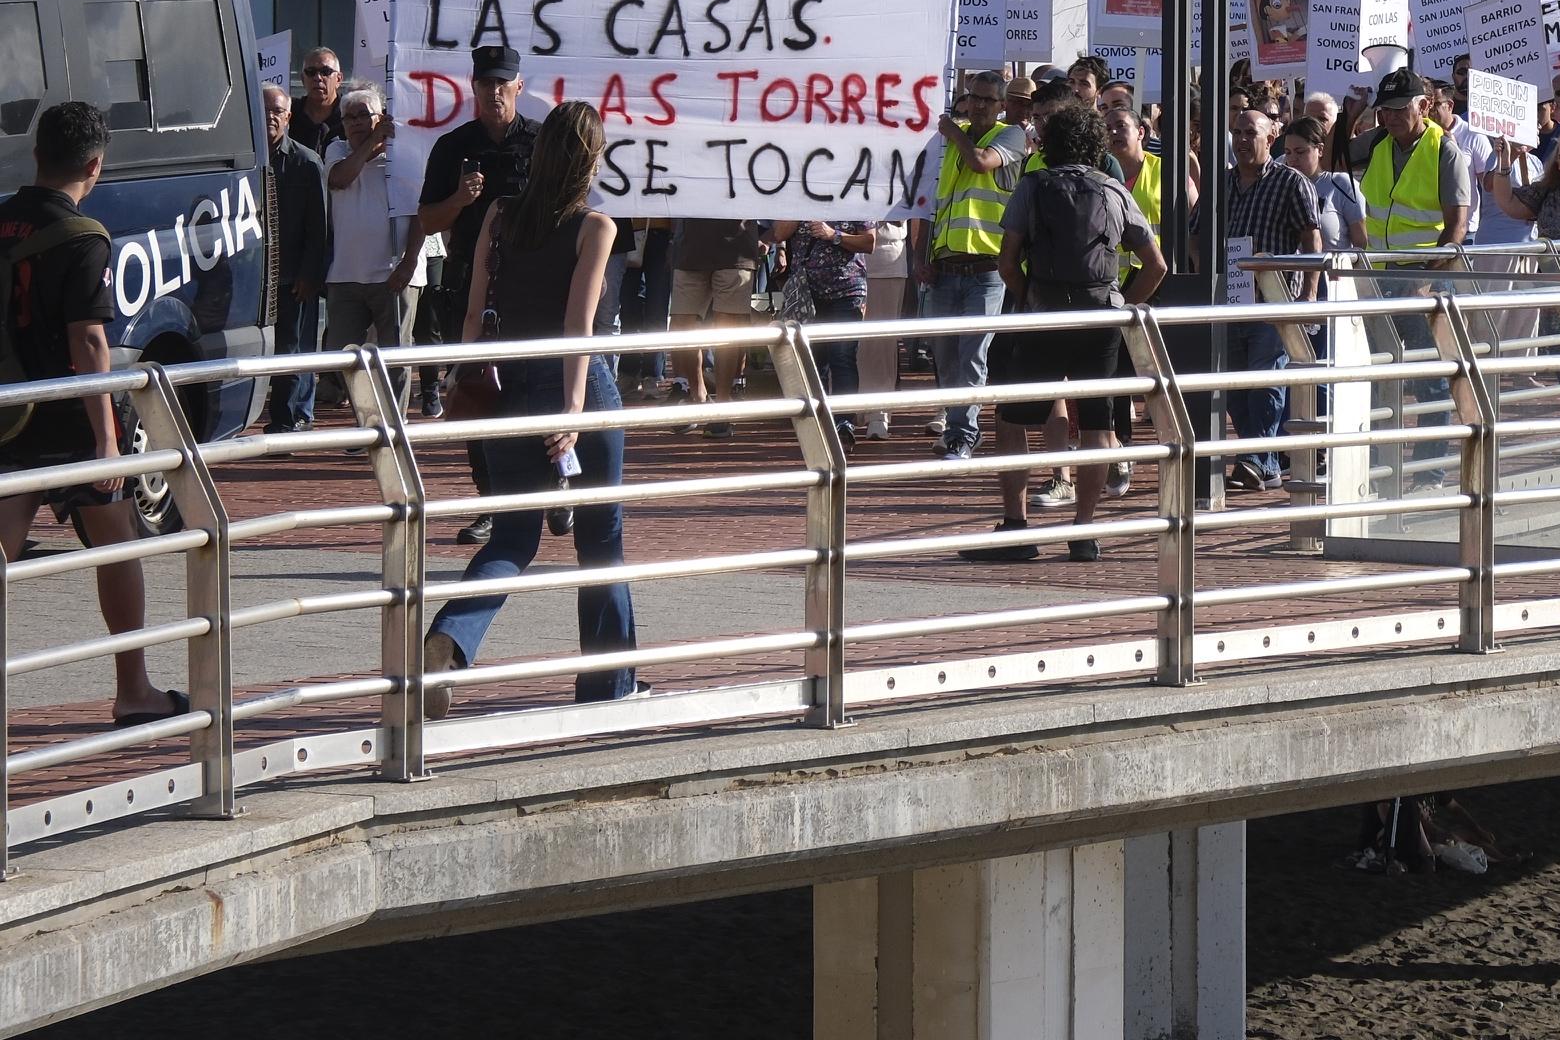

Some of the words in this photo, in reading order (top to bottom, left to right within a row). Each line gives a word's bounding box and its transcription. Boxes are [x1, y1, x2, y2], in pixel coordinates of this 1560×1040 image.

[1006, 9, 1020, 20] ON
[1022, 9, 1039, 20] LAS
[1312, 3, 1332, 14] SAN
[1335, 5, 1361, 16] FRAN
[1419, 13, 1438, 24] SAN
[1439, 5, 1463, 19] JUAN
[1481, 3, 1522, 25] BARRIO
[973, 13, 998, 26] MÁS
[1368, 13, 1384, 26] CON
[1385, 11, 1398, 24] LAS
[1006, 29, 1038, 40] ORRES
[1330, 21, 1360, 33] UNID
[1426, 22, 1462, 38] UNIDOS
[1471, 17, 1537, 46] ESCALERITAS
[957, 35, 977, 47] GC
[1317, 38, 1355, 50] SOMOS
[1421, 40, 1451, 55] SOMOS
[1453, 34, 1468, 46] MÁ
[1484, 37, 1528, 59] UNIDOS
[1094, 46, 1137, 58] SOMOS
[262, 55, 277, 68] RIO
[1480, 59, 1515, 75] OMOS
[1517, 51, 1540, 65] MÁS
[1109, 67, 1136, 80] LPG
[1473, 73, 1503, 96] POR
[1506, 82, 1529, 102] UN
[717, 69, 939, 132] TORRES
[599, 138, 678, 197] SE
[115, 176, 262, 317] OLICIA
